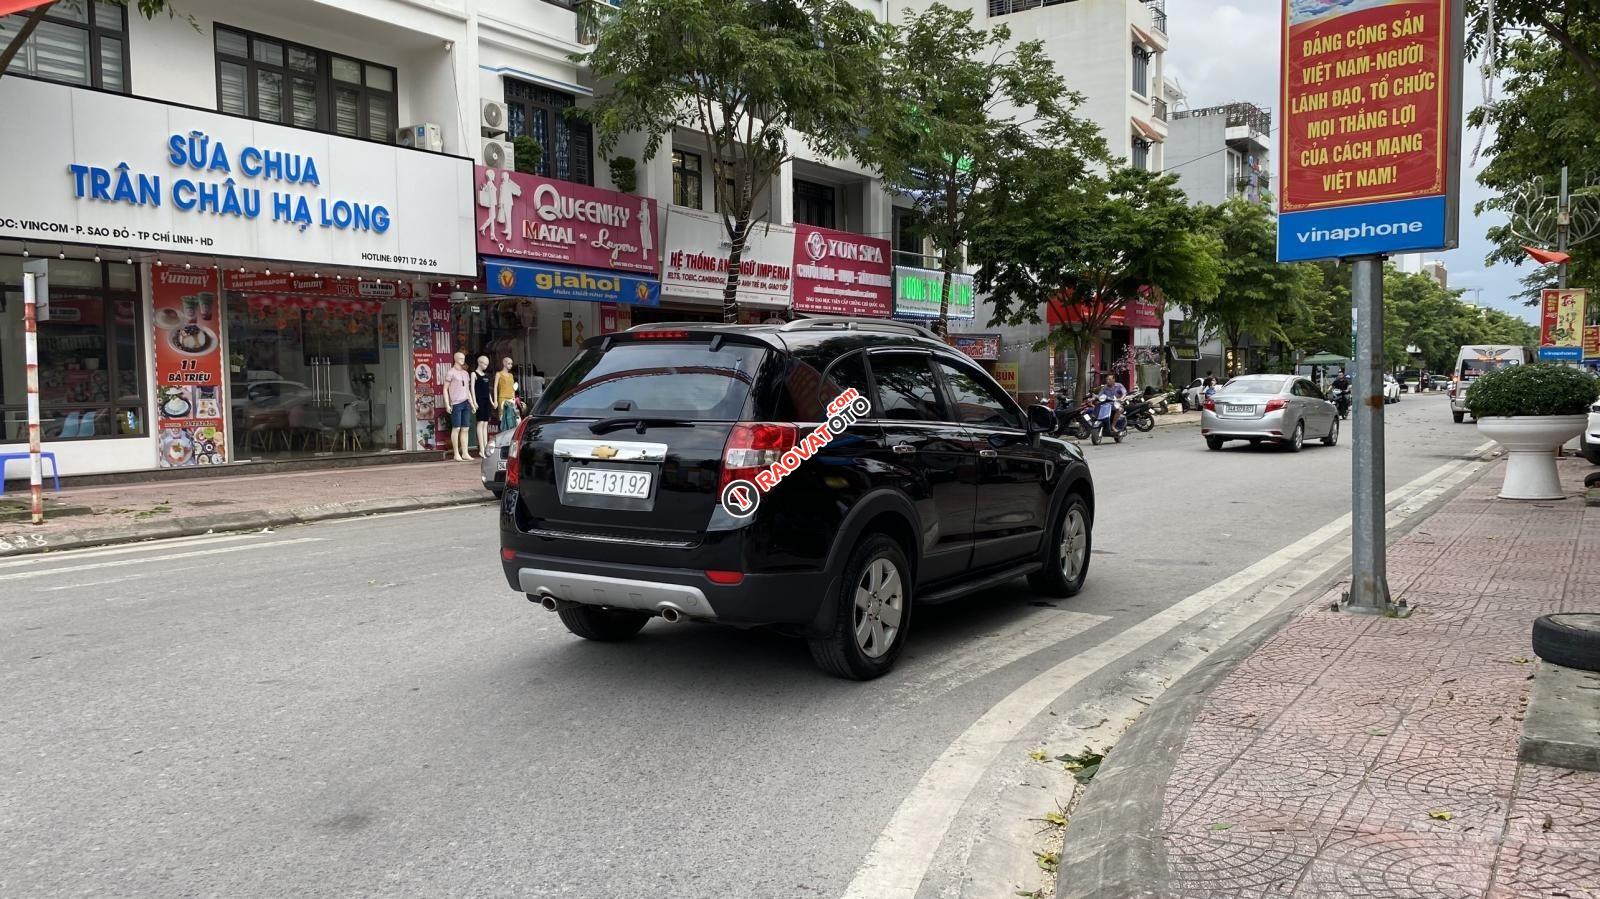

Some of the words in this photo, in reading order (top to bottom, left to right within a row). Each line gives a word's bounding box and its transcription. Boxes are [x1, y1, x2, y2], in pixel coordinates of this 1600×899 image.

[1303, 31, 1341, 57] ĐẢNG
[1346, 24, 1387, 49] CỘNG
[1392, 10, 1424, 38] SẢN
[1302, 62, 1332, 86] VIỆT
[1336, 42, 1424, 78] NAM-NGƯỜI
[1292, 90, 1328, 114] LÃNH
[1332, 86, 1366, 109] ĐẠO,
[1370, 73, 1390, 100] TỔ
[1393, 69, 1435, 96] CHỨC
[1307, 117, 1335, 140] MỌI
[1339, 107, 1388, 134] THẮNG
[1392, 104, 1416, 128] LỢI
[169, 130, 231, 172] SỮA
[240, 146, 320, 186] CHUA
[1300, 142, 1328, 167] CỦA
[1333, 140, 1372, 163] CÁCH
[1377, 132, 1423, 158] MẠNG
[1323, 169, 1353, 194] VIỆT
[1356, 166, 1397, 188] NAM!
[67, 161, 162, 207] TRÂN
[171, 177, 261, 218] CHÂU
[272, 192, 313, 230] HẠ
[320, 198, 390, 233] LONG
[20, 220, 69, 234] VINCOM
[76, 225, 86, 235] P.
[87, 226, 110, 237] SAO
[113, 226, 130, 239] ĐỎ
[138, 231, 150, 240] TP
[152, 231, 170, 243] CHÍ
[172, 234, 194, 245] LINH
[200, 237, 214, 246] HD
[1296, 220, 1424, 243] vinaphone
[361, 252, 392, 263] HOTLINE:
[393, 255, 409, 264] 0971
[411, 256, 418, 264] 17
[419, 258, 428, 266] 26
[429, 259, 438, 267] 26
[670, 249, 683, 270] HỆ
[686, 250, 716, 273] THỐNG
[827, 239, 858, 260] YUN
[859, 244, 884, 264] SPA
[160, 271, 210, 288] Yummy
[535, 271, 621, 291] giahoi
